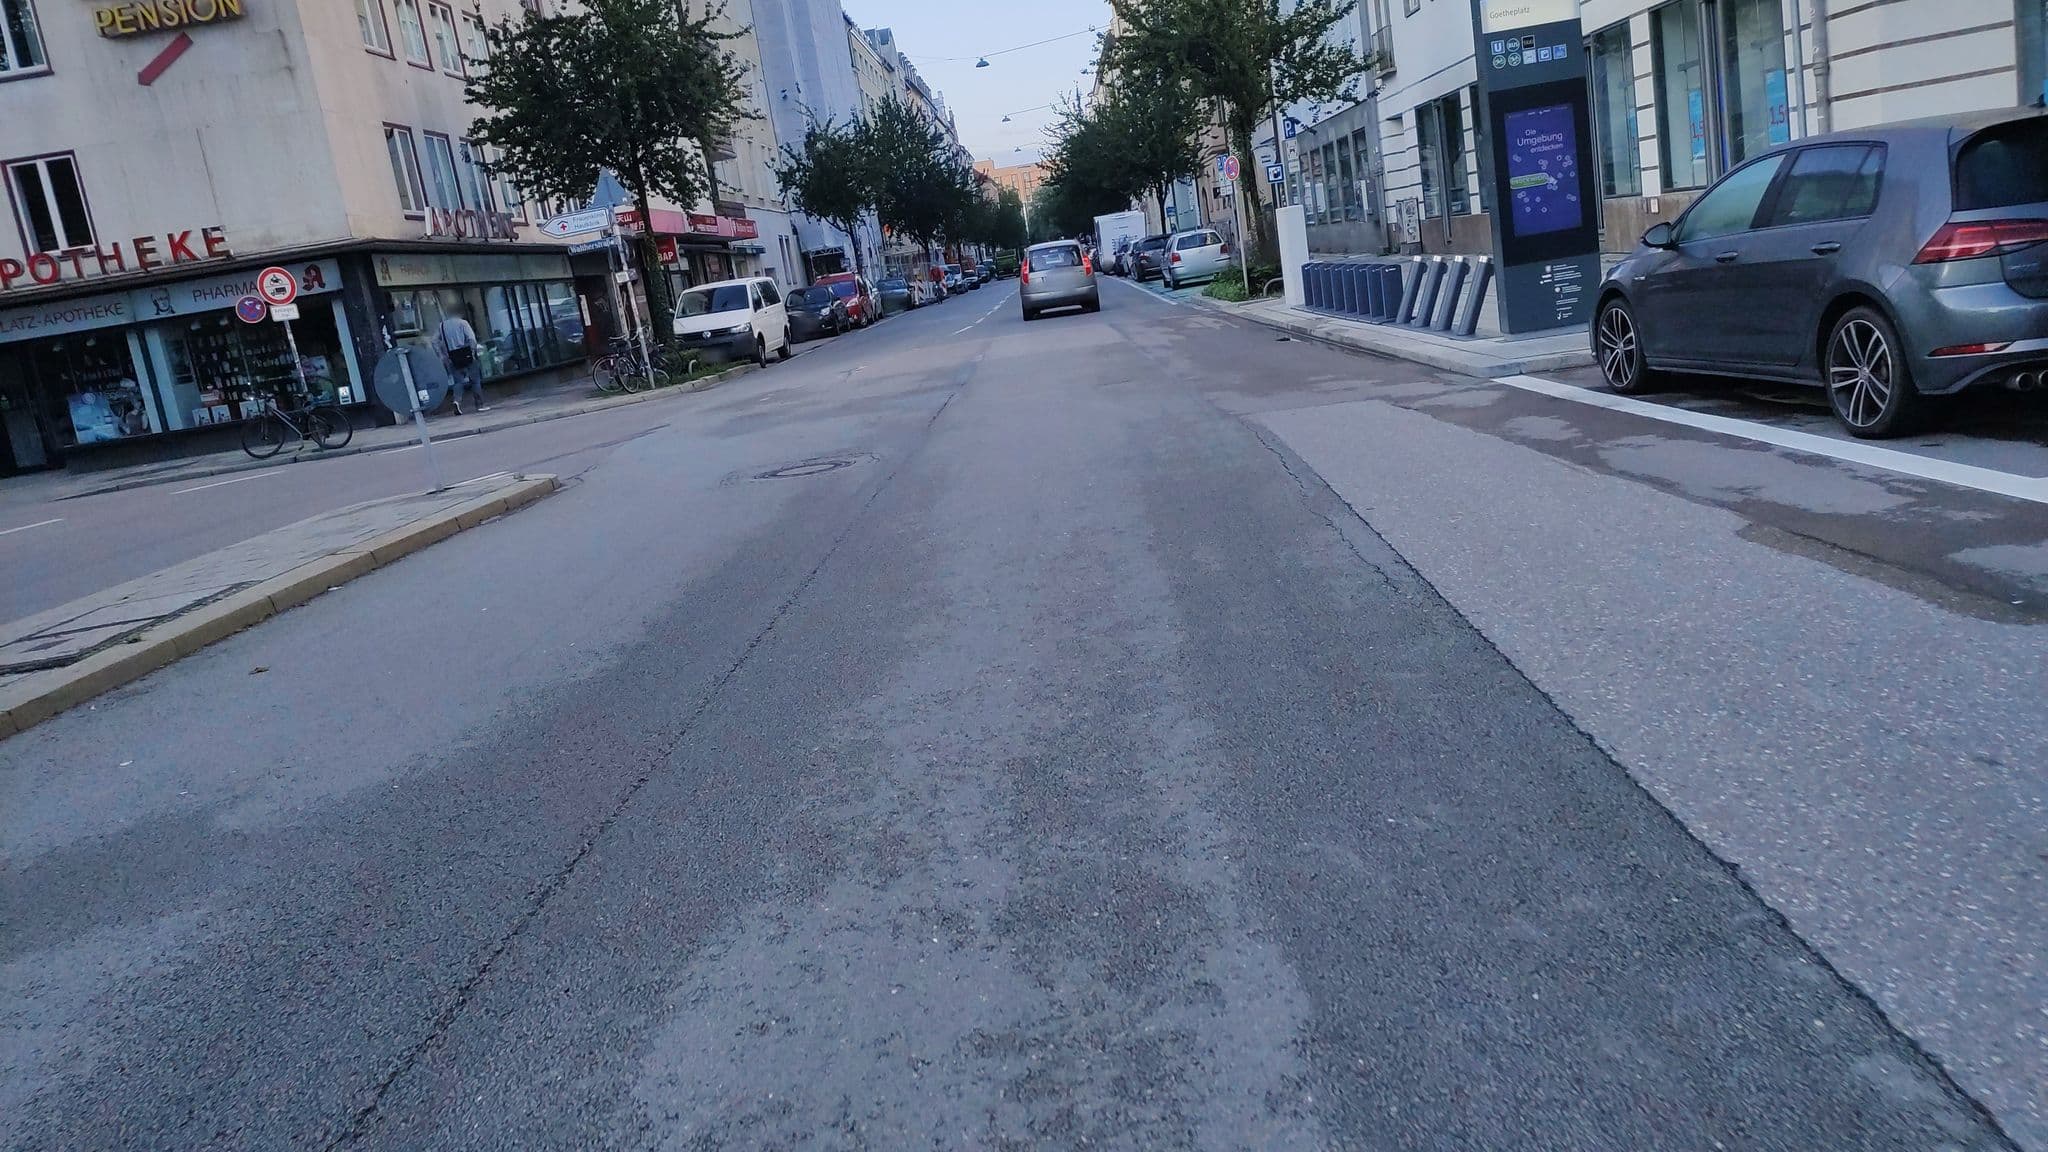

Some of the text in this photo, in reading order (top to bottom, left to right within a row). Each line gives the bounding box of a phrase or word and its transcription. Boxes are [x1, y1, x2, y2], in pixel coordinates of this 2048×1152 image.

[96, 0, 241, 34] PENSION
[1489, 7, 1531, 20] Goetheplatz
[1516, 132, 1563, 147] Umgebung
[1525, 129, 1537, 137] Die
